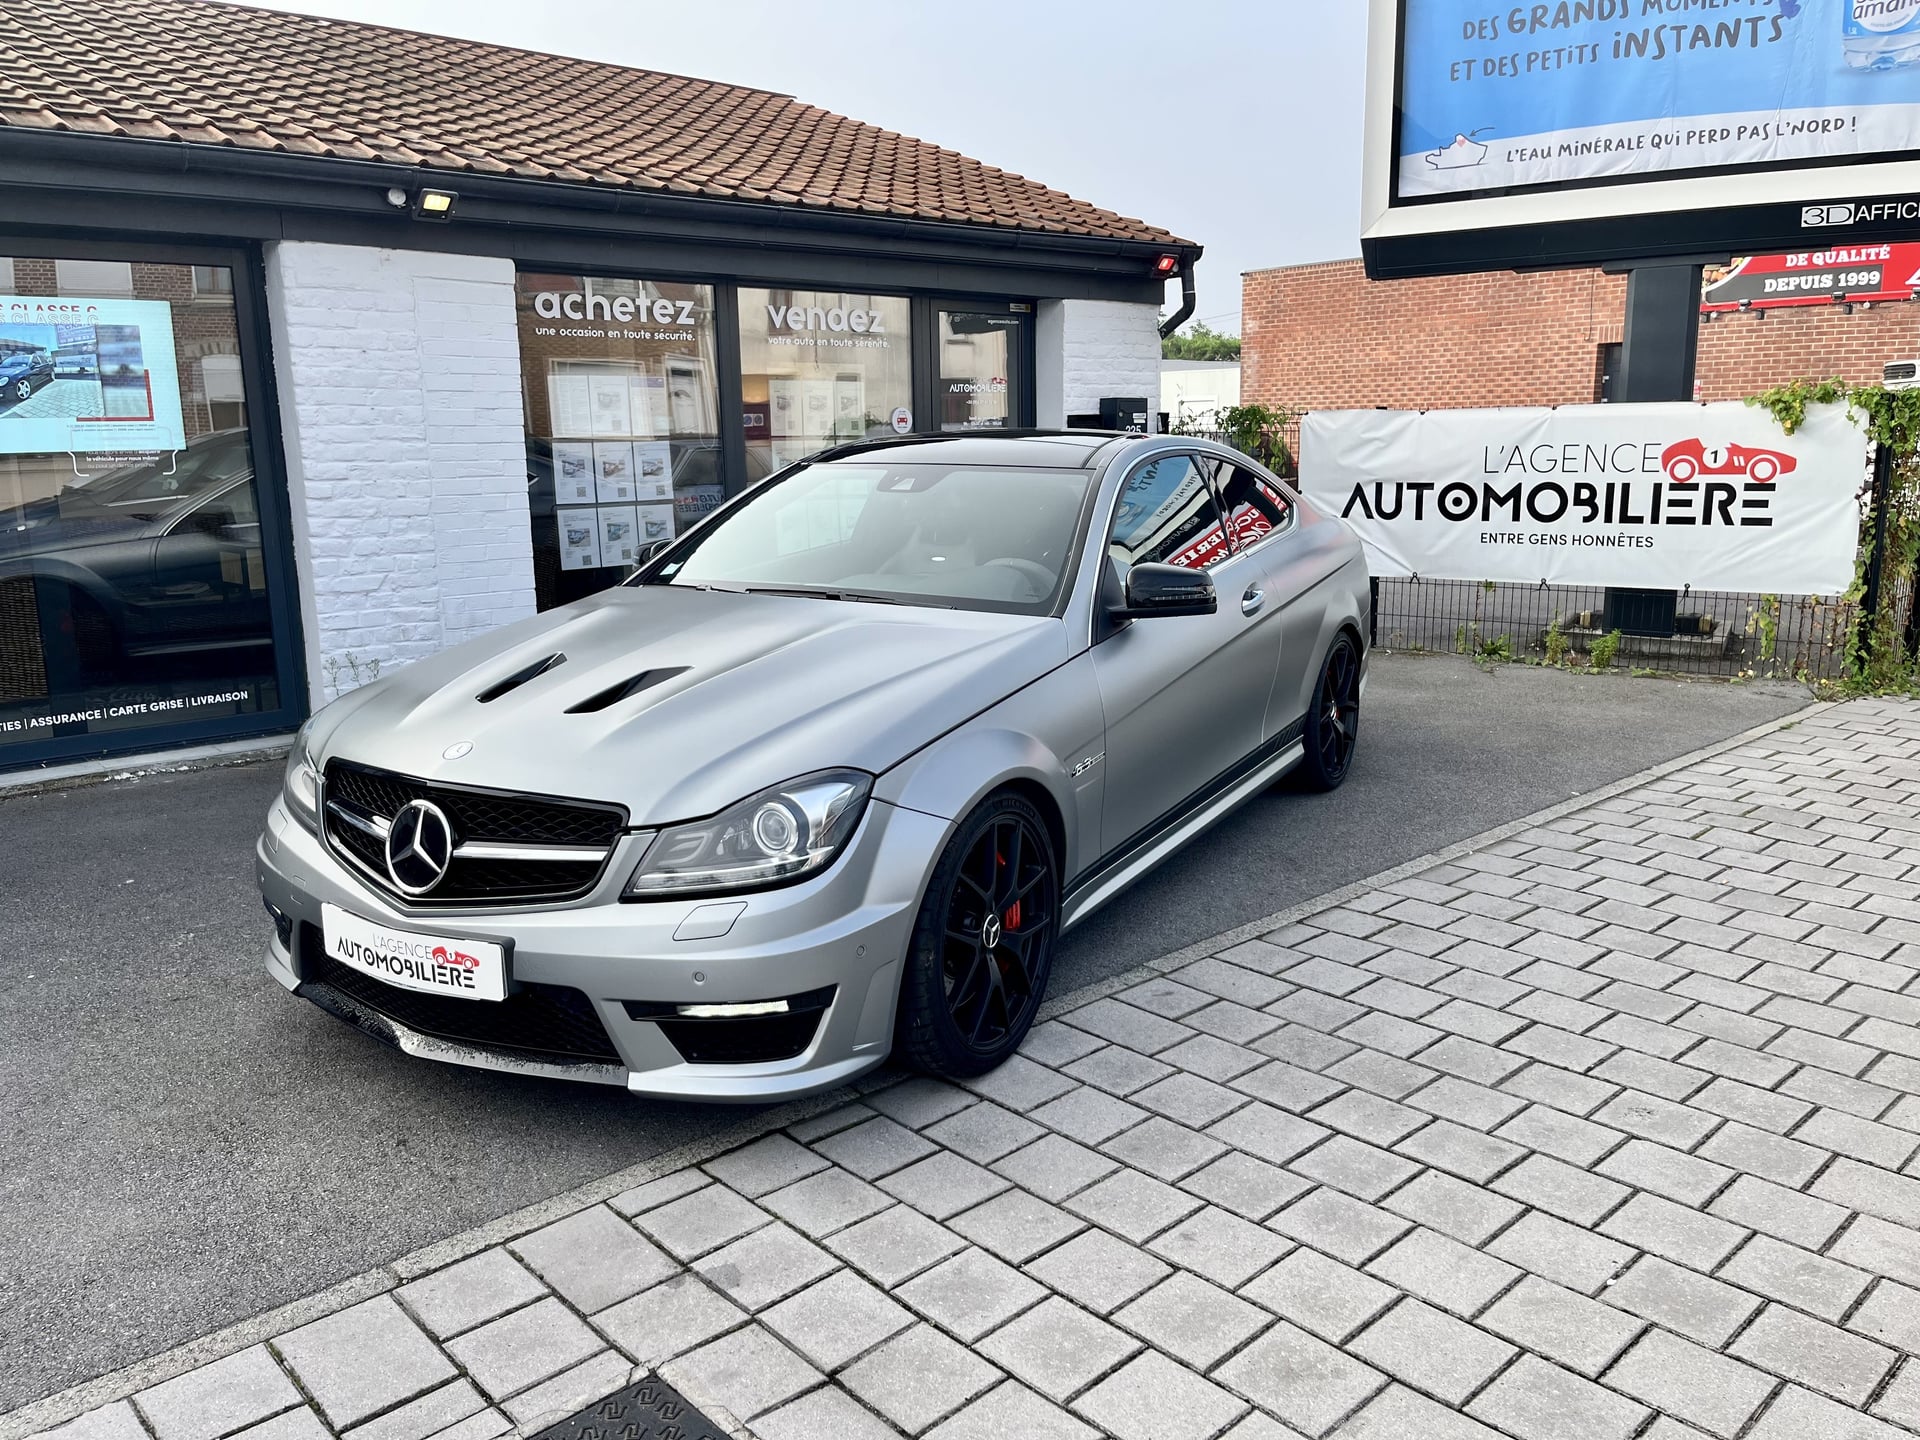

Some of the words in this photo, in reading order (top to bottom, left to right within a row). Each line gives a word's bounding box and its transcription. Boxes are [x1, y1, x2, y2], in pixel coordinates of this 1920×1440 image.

[1463, 16, 1499, 40] DES
[1507, 0, 1629, 34] GRANDS
[1451, 59, 1477, 81] ET
[1483, 53, 1519, 77] DES
[1506, 145, 1551, 162] L'EAU
[1687, 128, 1730, 145] PERD
[1737, 123, 1770, 141] PAS
[1776, 118, 1845, 136] L'NORD
[1802, 205, 1854, 226] 3D
[1855, 202, 1920, 221] AFFIC
[1786, 253, 1808, 267] DE
[1812, 244, 1891, 265] QUALITÉ
[1764, 274, 1833, 292] DEPUIS
[1838, 271, 1881, 287] 1999
[535, 290, 695, 325] achetez
[768, 302, 884, 332] vendez
[536, 327, 556, 336] une
[560, 326, 604, 338] occasion
[624, 331, 651, 339] toute
[654, 329, 695, 341] sécurité.
[768, 337, 791, 345] votre
[794, 338, 815, 346] auto
[831, 338, 853, 347] toute
[1484, 443, 1662, 473] L'AGENCE
[1341, 482, 1776, 526] AUTOMOBILIERE
[1480, 533, 1524, 545] ENTRE
[1529, 534, 1567, 545] GENS
[1572, 532, 1654, 548] HONNÊTES
[30, 710, 101, 728] ASSURANCE
[110, 704, 147, 717] CARTE
[150, 699, 184, 712] GRISE
[191, 691, 248, 706] LIVRAISON
[372, 932, 433, 960] L'AGENCE
[337, 936, 476, 989] AUTOMOBILIERE
